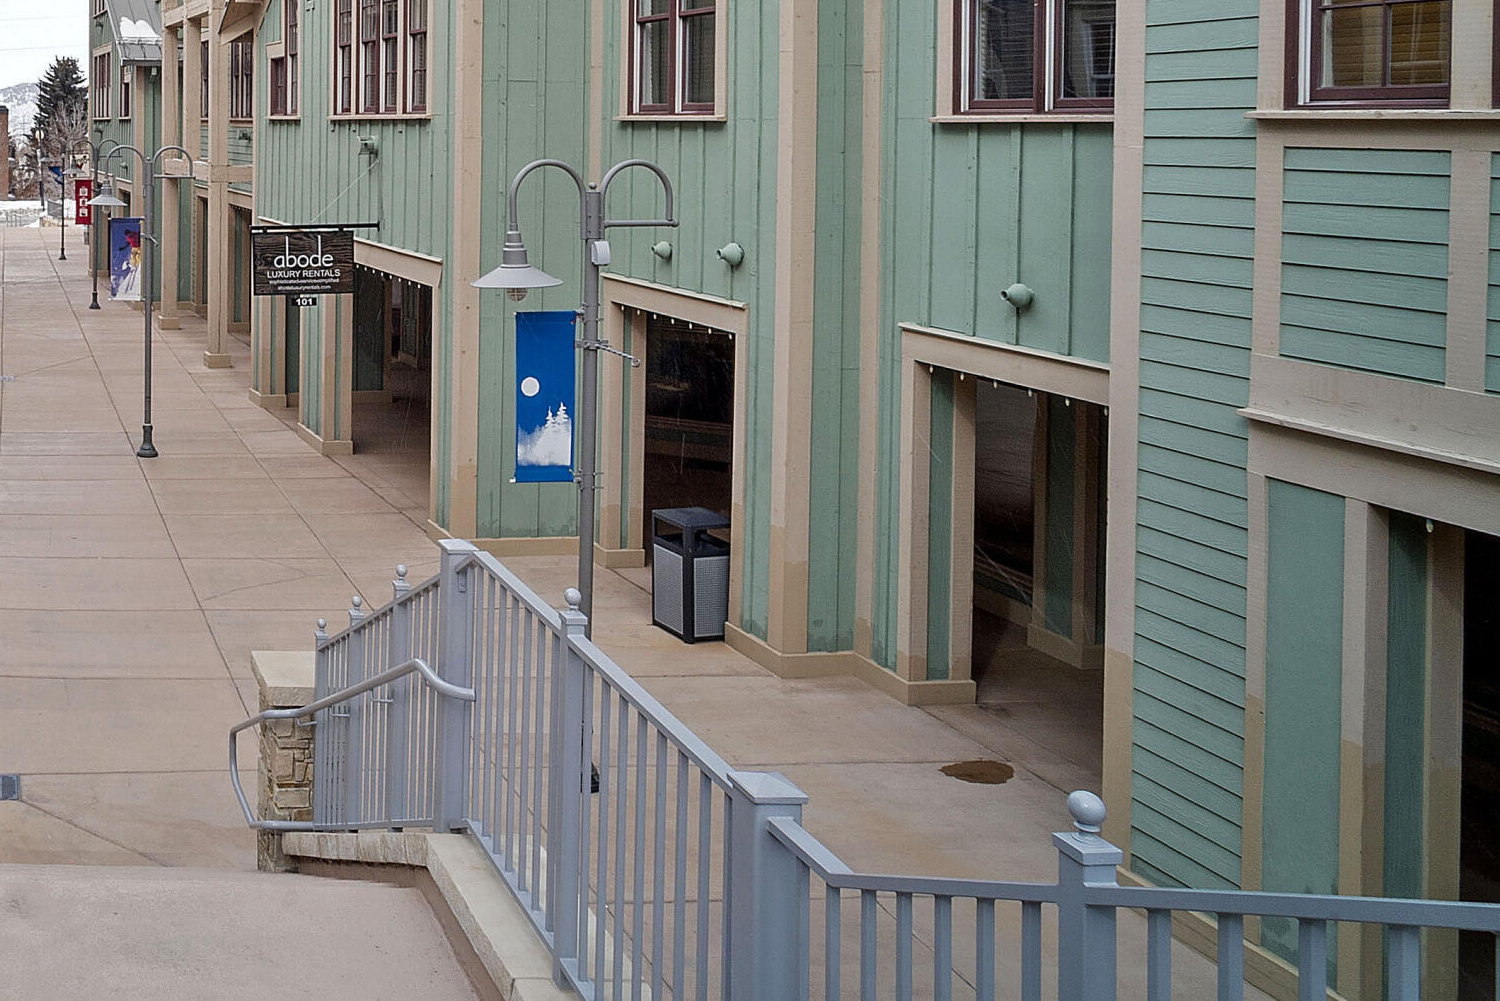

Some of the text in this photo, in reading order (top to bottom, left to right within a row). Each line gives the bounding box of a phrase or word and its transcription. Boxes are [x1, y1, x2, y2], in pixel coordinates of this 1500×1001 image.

[273, 234, 334, 268] abode
[266, 269, 341, 279] LUXURY RENTALS
[295, 298, 313, 306] 101
